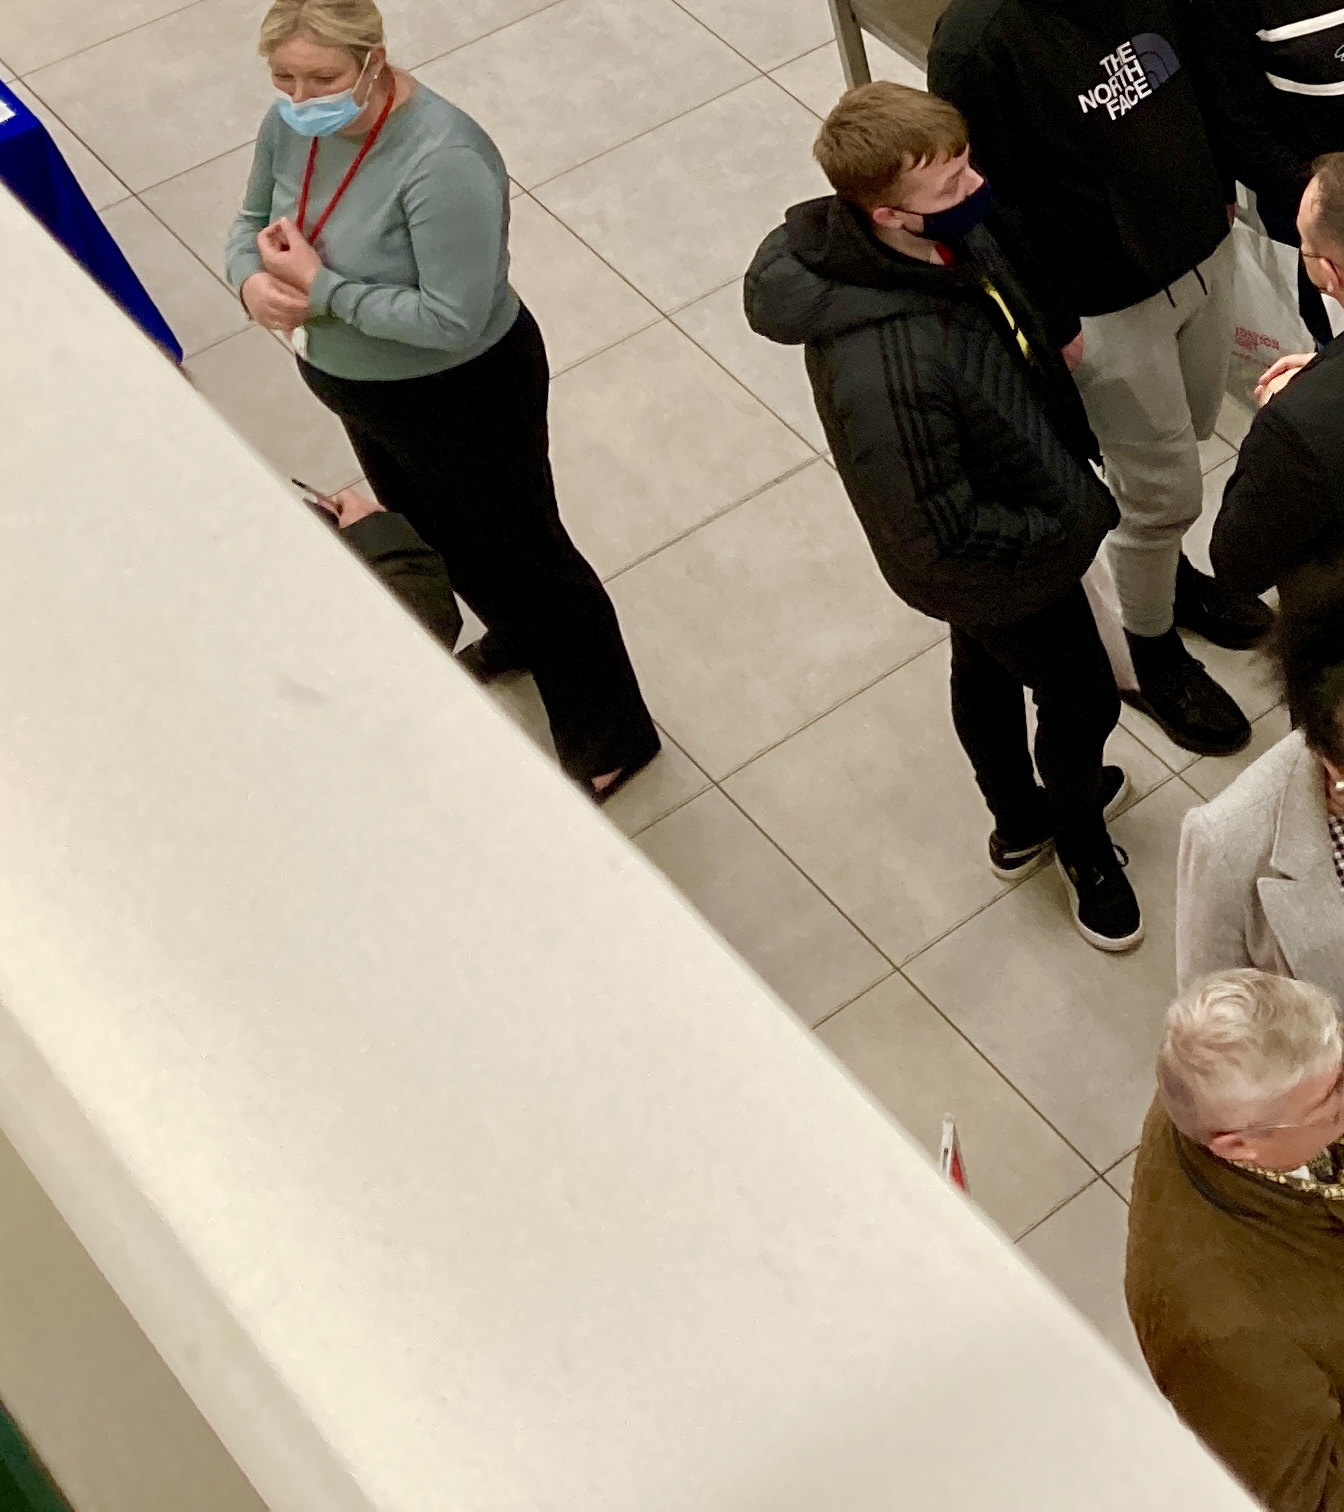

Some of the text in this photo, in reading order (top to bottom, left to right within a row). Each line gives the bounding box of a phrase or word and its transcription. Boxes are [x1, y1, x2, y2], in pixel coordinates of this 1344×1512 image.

[1099, 40, 1137, 77] THE
[1077, 58, 1145, 114] NORTH
[1106, 76, 1153, 121] FACE
